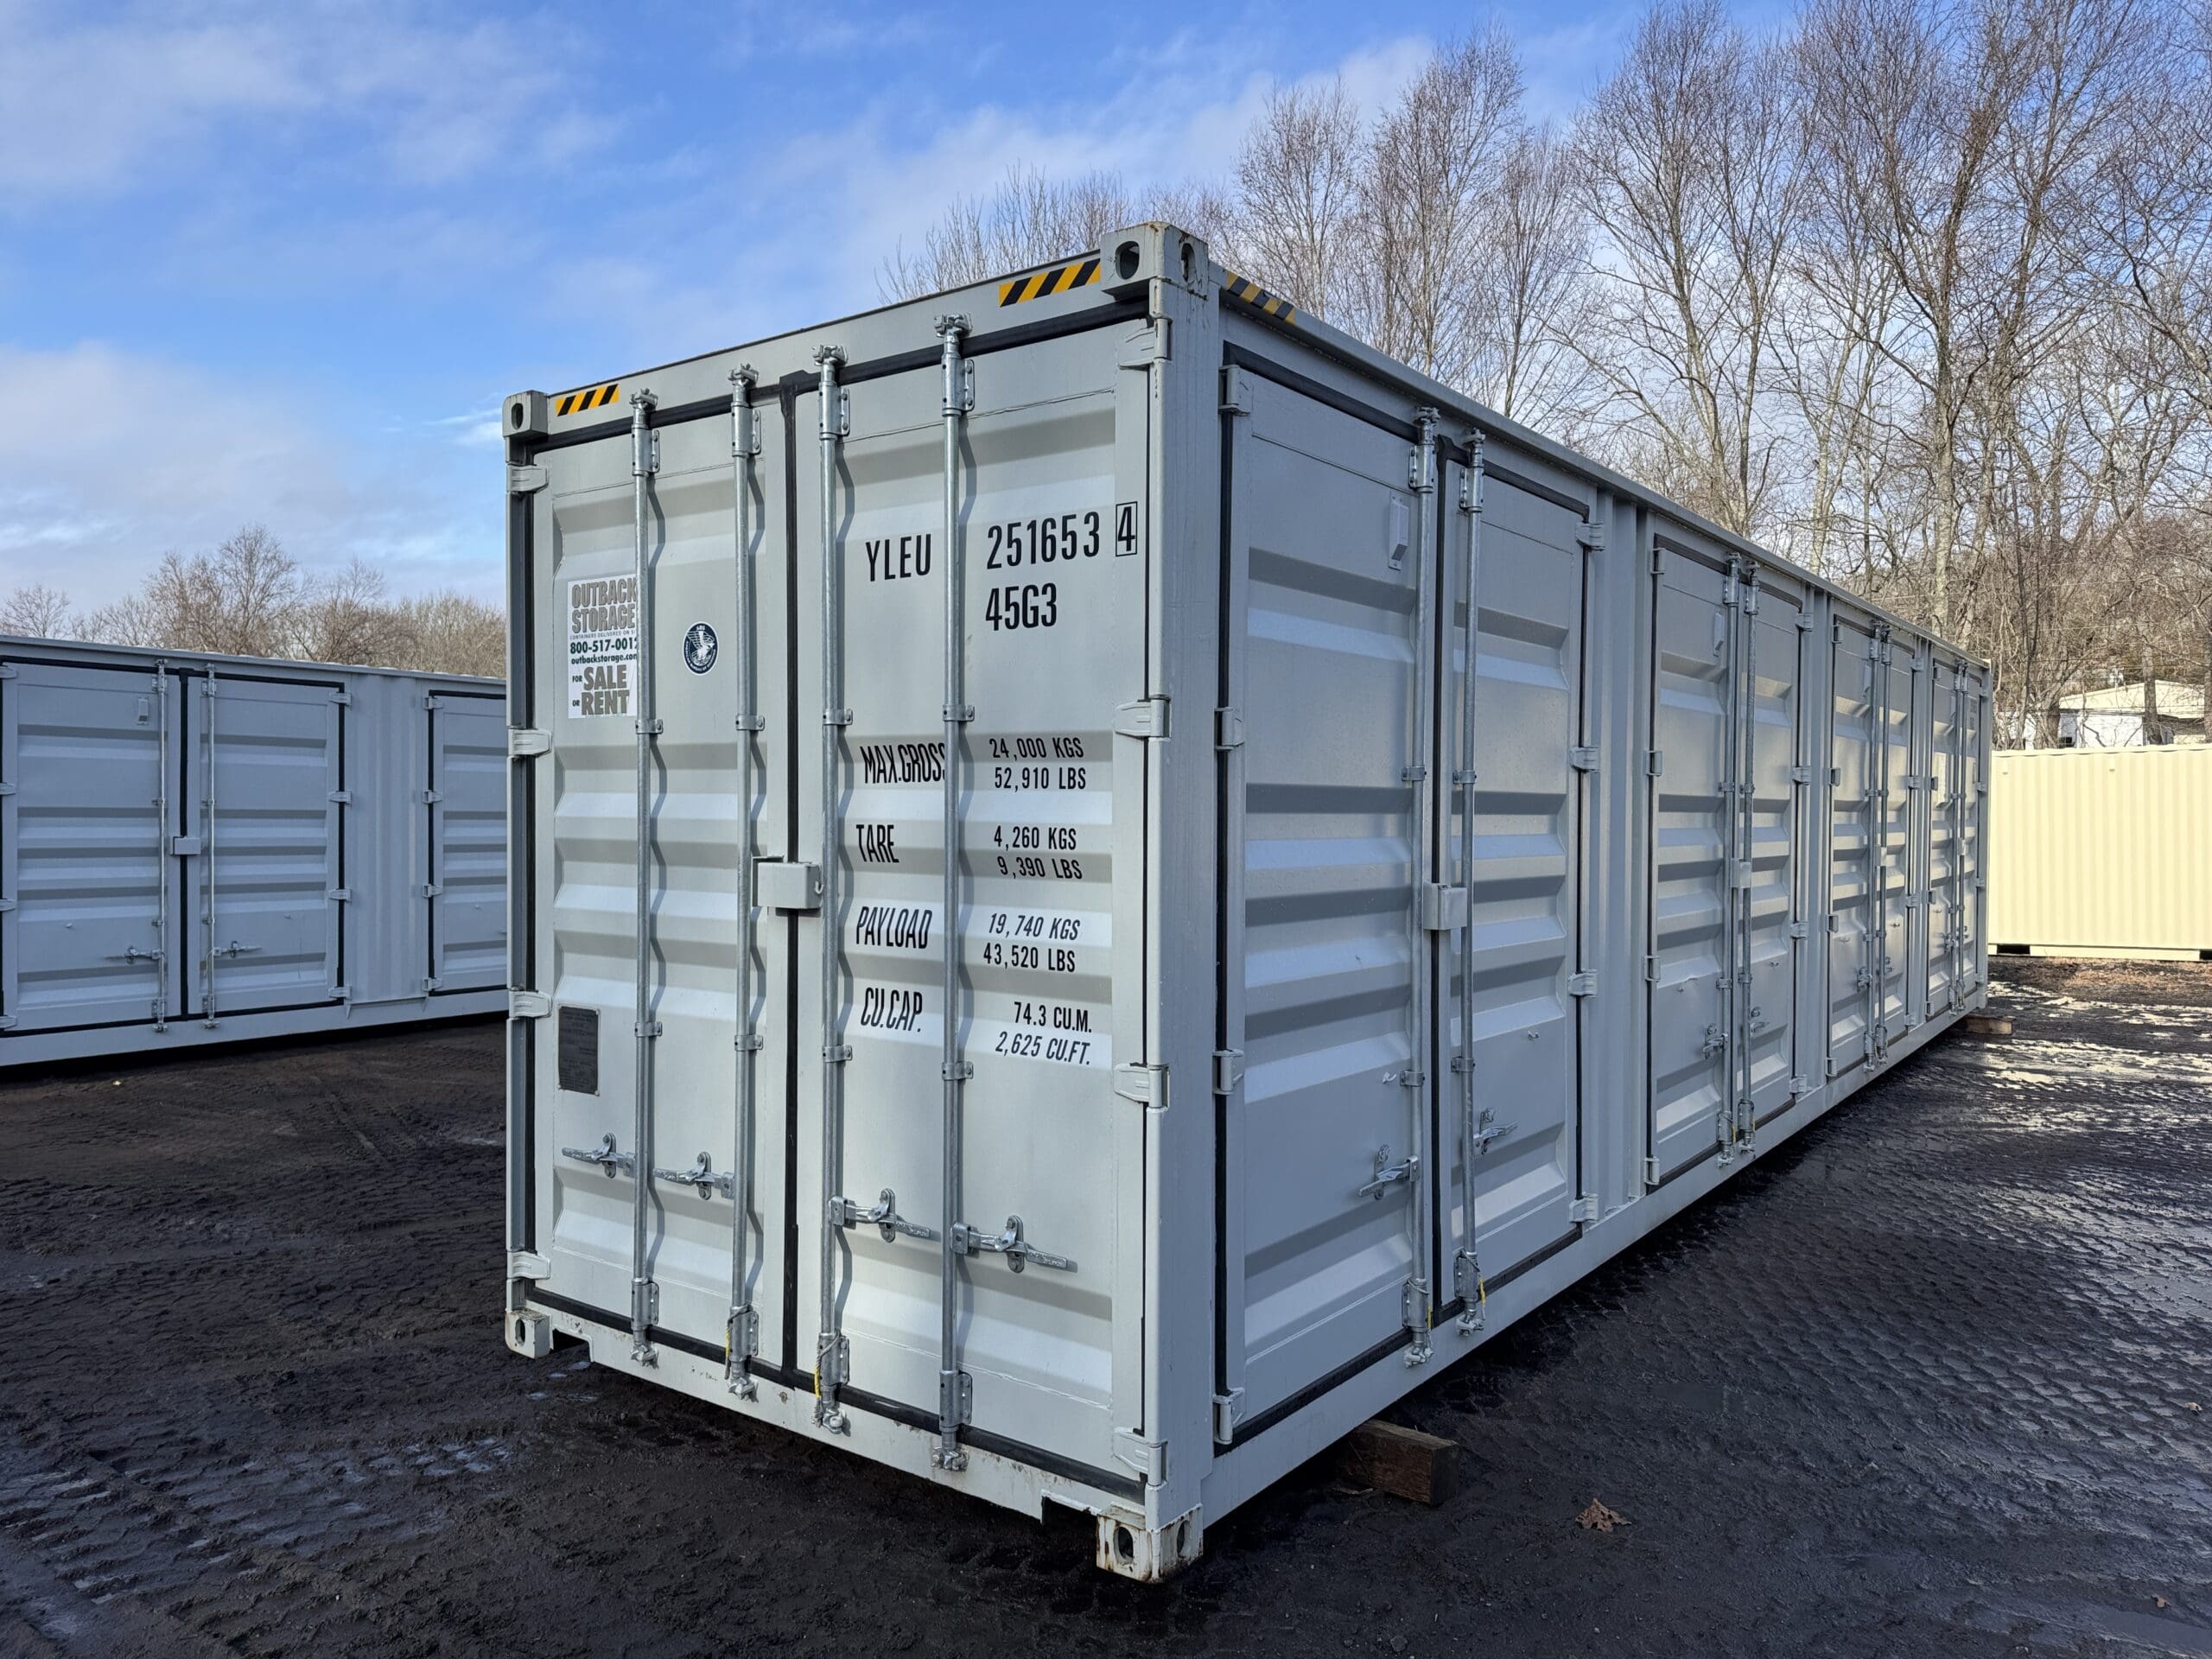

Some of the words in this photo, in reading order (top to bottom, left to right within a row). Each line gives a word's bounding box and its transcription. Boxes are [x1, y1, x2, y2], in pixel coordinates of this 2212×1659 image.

[865, 533, 931, 582] YLEU
[986, 511, 1100, 569] 251653
[1117, 505, 1136, 552] 4
[571, 577, 637, 608] OUTBACK
[985, 582, 1058, 632] 45G3
[571, 603, 636, 634] STORAGE
[583, 664, 627, 690] SALE
[581, 690, 630, 715] RENT
[988, 737, 1047, 761] 24,000
[1052, 737, 1084, 759] KGS
[995, 766, 1050, 792] 52,910
[1058, 766, 1086, 790] LBS
[855, 823, 899, 863] TARE
[994, 825, 1040, 851] 4,260
[1048, 826, 1077, 851] KGS
[997, 855, 1046, 880] 9,390
[1052, 858, 1083, 880] LBS
[855, 906, 933, 950] PAYLOAD
[988, 912, 1045, 938] 19,740
[1048, 917, 1081, 941] KGS
[982, 942, 1039, 969] 43,520
[1047, 948, 1076, 973] LBS
[860, 987, 923, 1033] CU.CAP.
[1014, 1001, 1047, 1027] 74.3
[1052, 1006, 1092, 1033] CU.M.
[995, 1031, 1043, 1058] 2,625
[1046, 1037, 1091, 1065] CU.FT.
